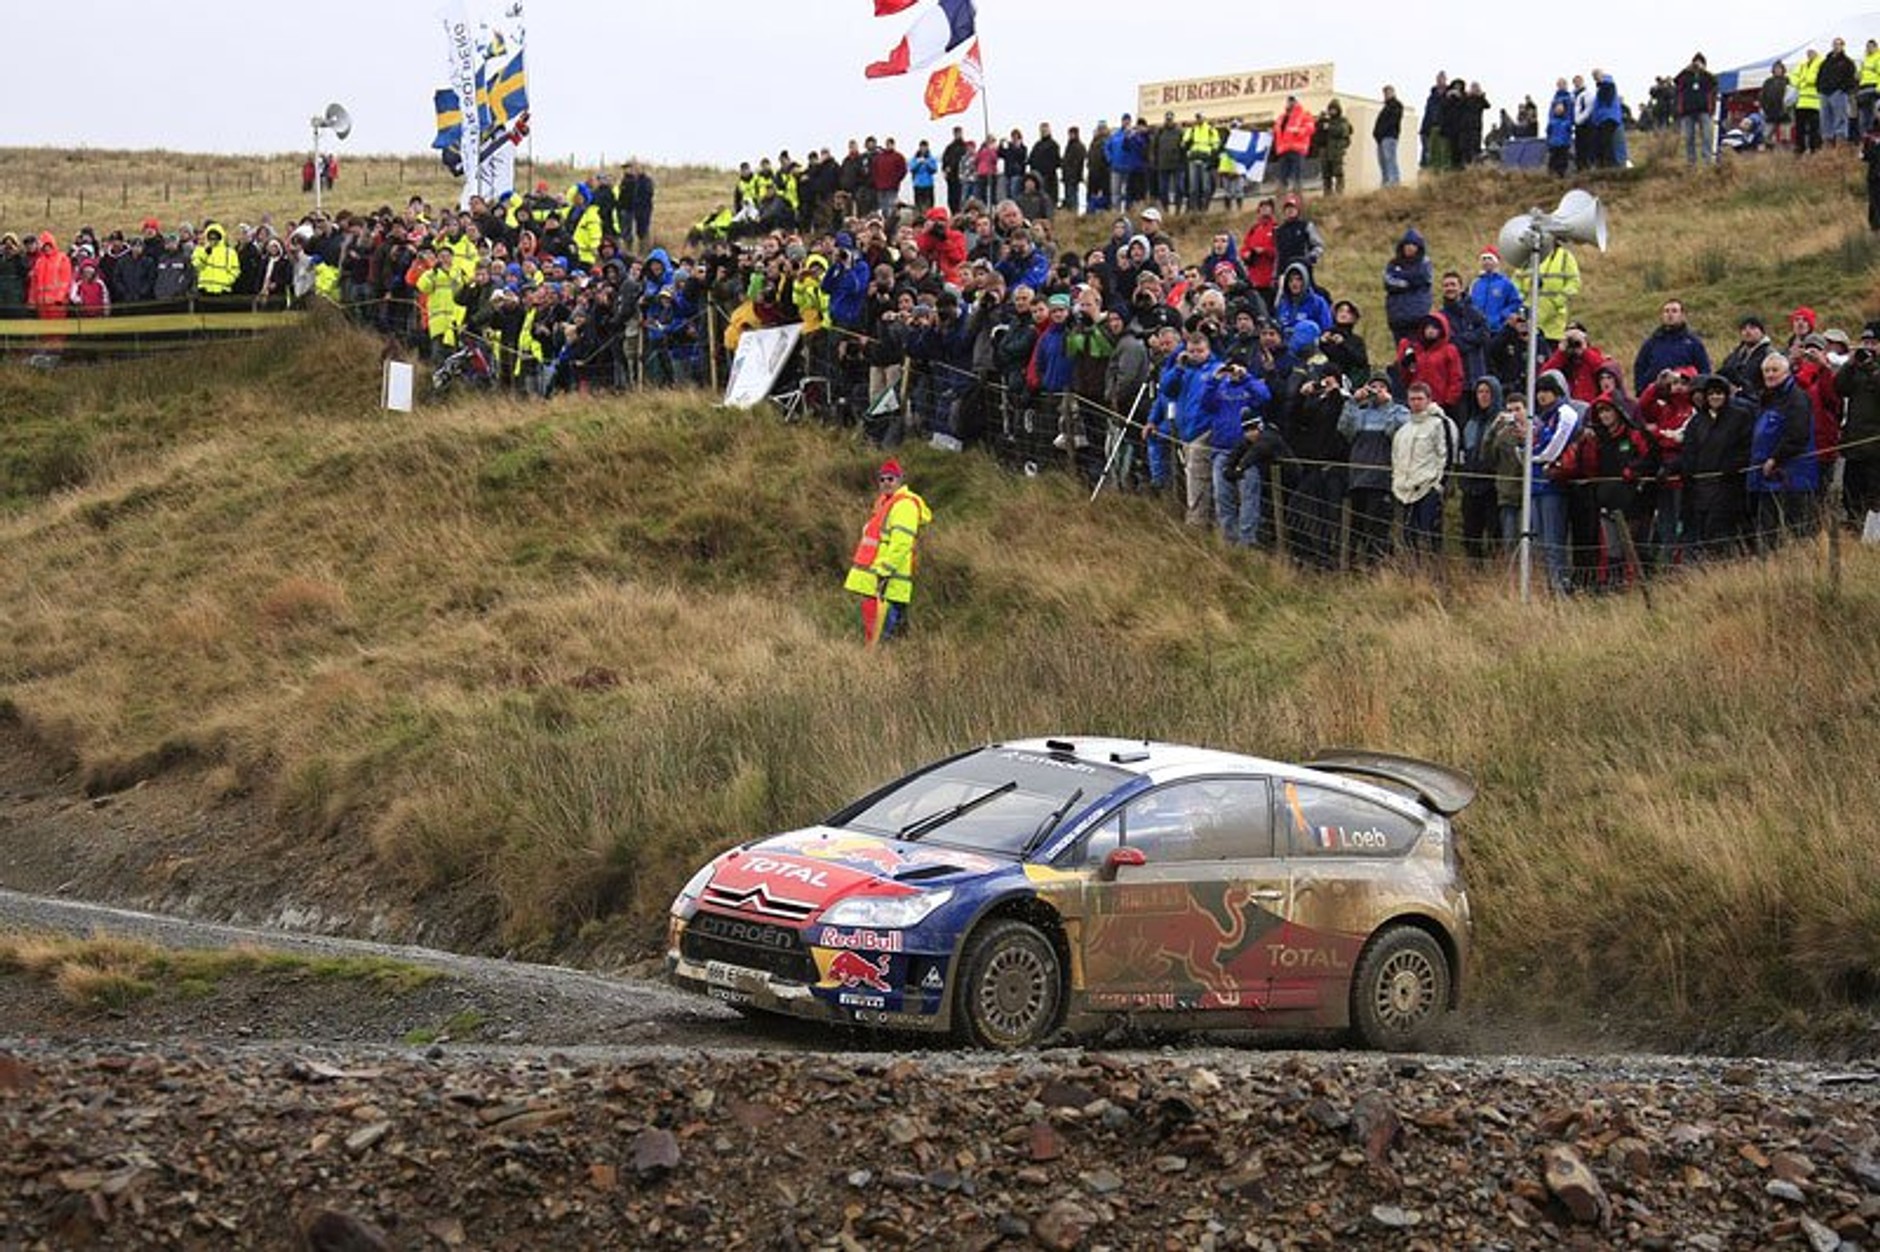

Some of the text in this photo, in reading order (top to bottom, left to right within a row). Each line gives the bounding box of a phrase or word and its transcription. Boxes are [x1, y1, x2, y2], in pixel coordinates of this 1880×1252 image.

[1162, 78, 1240, 103] BURGERS
[1243, 74, 1255, 94] &
[1261, 70, 1310, 93] FRIES
[1339, 826, 1386, 848] Loeb
[741, 857, 828, 888] TOTAL
[820, 926, 903, 952] Red Bull
[1267, 944, 1348, 967] TOTAL
